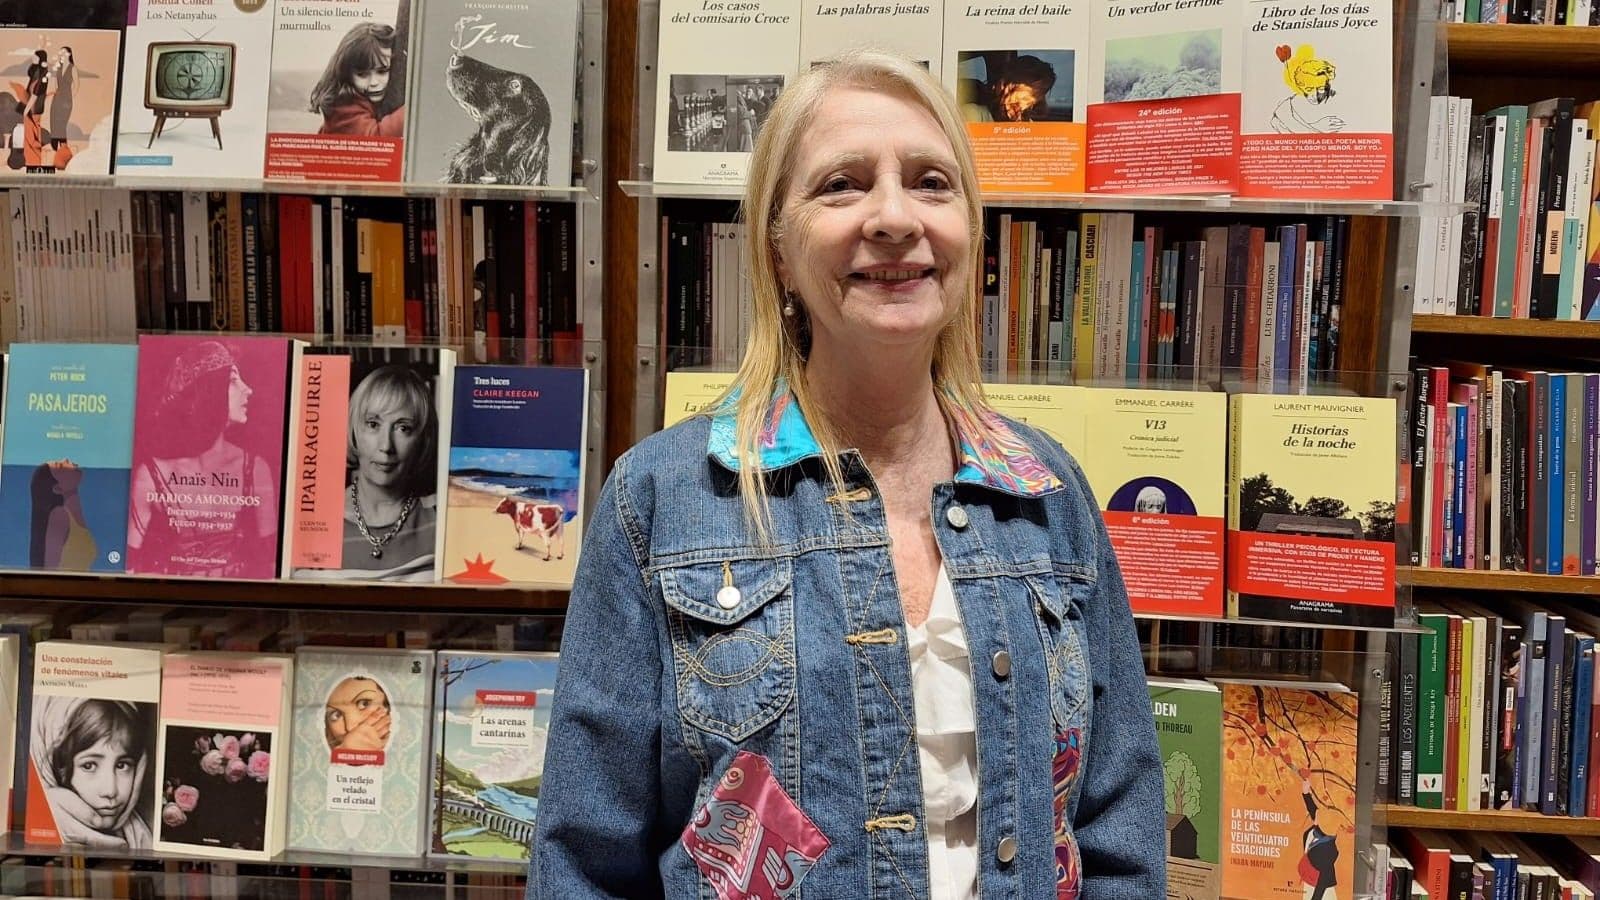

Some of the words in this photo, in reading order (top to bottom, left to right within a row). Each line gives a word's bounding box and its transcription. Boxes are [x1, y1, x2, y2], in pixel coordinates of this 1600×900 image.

[702, 0, 724, 11] Los
[726, 2, 760, 11] casos
[816, 4, 838, 15] Las
[840, 4, 891, 16] palabras
[892, 3, 930, 16] justas
[965, 6, 980, 17] La
[984, 6, 1015, 16] reina
[1018, 5, 1037, 16] del
[1041, 5, 1072, 16] baile
[1107, 7, 1125, 17] Un
[1130, 2, 1172, 15] verdor
[1175, 0, 1224, 9] terrible
[1261, 7, 1296, 18] Libro
[1300, 5, 1316, 16] de
[1320, 5, 1339, 15] los
[1342, 3, 1370, 14] días
[147, 11, 162, 20] Los
[165, 11, 217, 22] Netanyahus
[281, 6, 295, 16] Un
[297, 7, 333, 17] silencio
[335, 7, 359, 18] lleno
[361, 8, 374, 18] de
[672, 13, 691, 24] del
[692, 13, 751, 24] comisario
[754, 13, 790, 24] Croce
[1252, 21, 1268, 32] de
[1271, 18, 1339, 31] Stanislaus
[1340, 16, 1378, 29] Joyce
[280, 21, 331, 31] murmullos
[450, 22, 536, 51] Jim
[1153, 107, 1183, 116] edición
[1085, 224, 1096, 259] CASCIARI
[1549, 230, 1558, 255] MORENO
[1084, 264, 1092, 285] LIONEL
[1083, 286, 1090, 295] DE
[1266, 264, 1276, 316] CHITARRONI
[1082, 297, 1090, 316] VALIJA
[1082, 317, 1089, 326] LA
[1264, 318, 1273, 337] LUIS
[473, 376, 489, 385] Tres
[490, 376, 510, 386] luces
[473, 389, 504, 397] CLAIRE
[505, 390, 539, 398] KEEGAN
[1418, 375, 1429, 402] Borges
[28, 392, 107, 414] PASAJEROS
[1017, 394, 1053, 402] CARRÈRE
[1115, 398, 1158, 406] EMMANUEL
[1159, 399, 1194, 408] CARRÈRE
[684, 402, 697, 412] La
[1273, 403, 1311, 411] LAURENT
[1313, 404, 1364, 413] MAUVIGNIER
[1417, 403, 1427, 427] factor
[1145, 419, 1167, 430] V13
[1290, 424, 1349, 436] Historias
[300, 360, 323, 513] IPARRAGUIRRE
[1417, 428, 1426, 437] El
[1282, 437, 1300, 447] de
[1302, 437, 1313, 448] la
[1317, 438, 1356, 449] noche
[1415, 446, 1425, 467] Pauls
[167, 471, 207, 486] Anaïs
[212, 472, 240, 487] Nin
[146, 492, 193, 504] DIARIOS
[195, 494, 261, 506] AMOROSOS
[1568, 493, 1576, 512] forma
[1568, 513, 1576, 522] La
[1298, 600, 1334, 608] ANAGRAMA
[41, 653, 58, 662] Una
[61, 656, 113, 665] constelación
[53, 668, 99, 677] fenómenos
[101, 671, 128, 679] vitales
[1153, 702, 1178, 717] DEN
[480, 716, 495, 725] Las
[497, 718, 527, 726] arenas
[479, 729, 526, 738] cantarinas
[1162, 723, 1193, 734] THOREAU
[1402, 728, 1412, 743] LOS
[336, 774, 347, 783] Un
[349, 775, 374, 785] reflejo
[1401, 772, 1411, 798] GABRIEL
[342, 786, 367, 794] velado
[343, 795, 350, 804] el
[351, 796, 376, 805] cristal
[1231, 808, 1242, 819] LA
[1244, 809, 1291, 824] PENÍNSULA
[1231, 820, 1242, 830] DE
[1244, 821, 1260, 832] LAS
[1230, 832, 1289, 847] VEINTICUATRO
[1231, 843, 1281, 858] ESTACIONES
